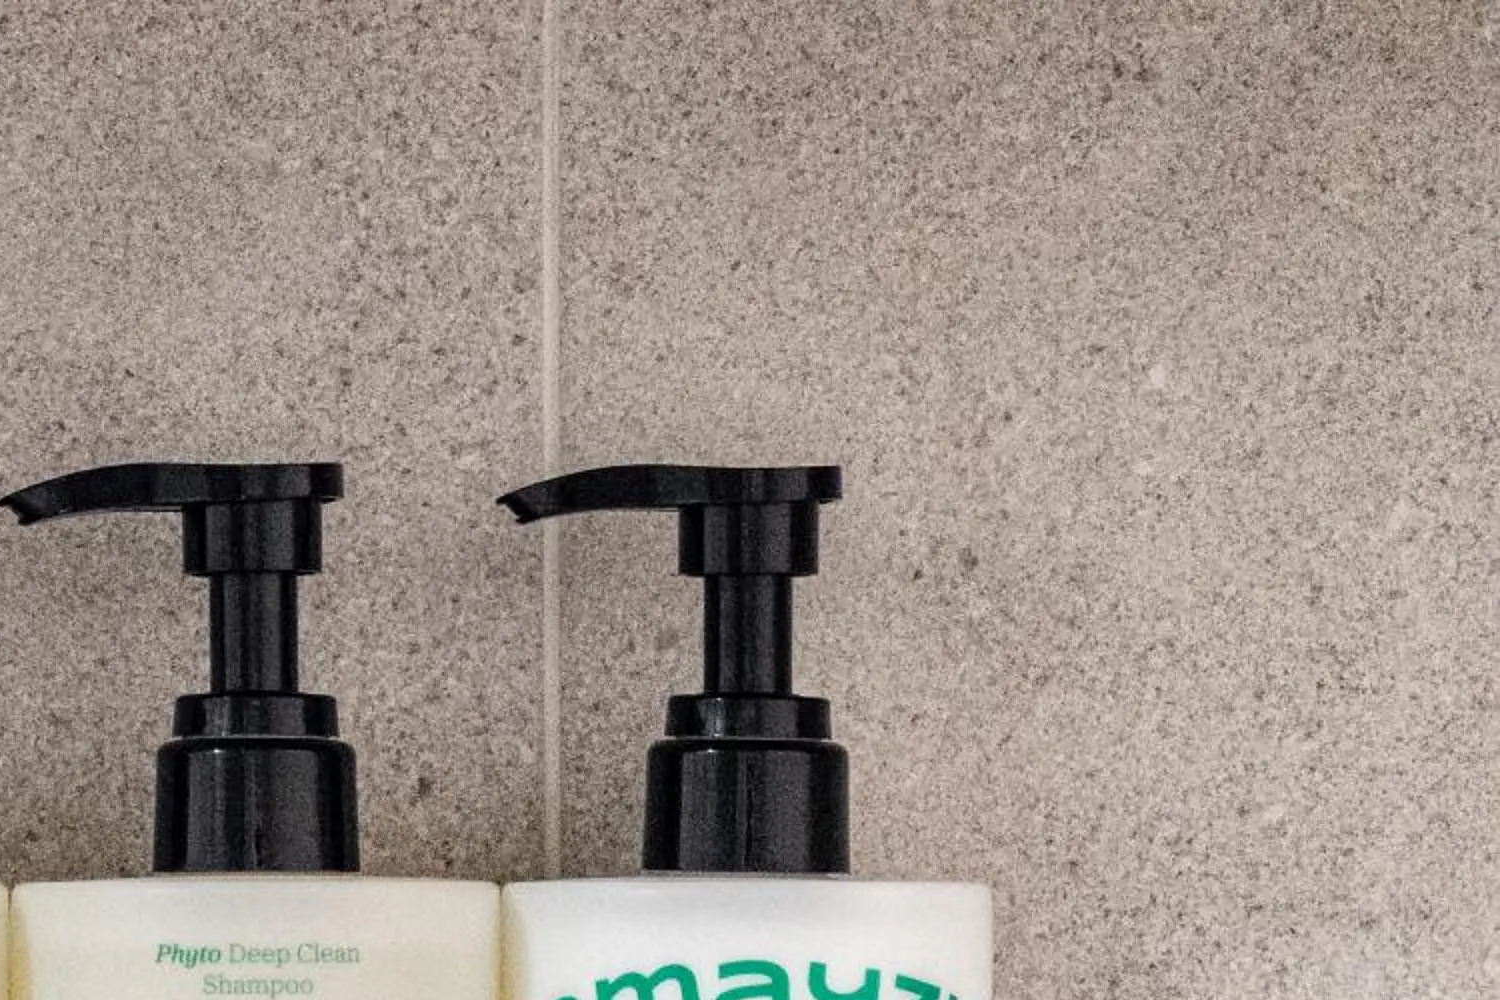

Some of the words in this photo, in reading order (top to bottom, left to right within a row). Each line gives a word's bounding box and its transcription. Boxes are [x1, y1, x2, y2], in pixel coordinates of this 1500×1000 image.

[156, 942, 222, 969] Phyto
[228, 943, 289, 970] Deep
[296, 943, 361, 965] Clean
[202, 974, 314, 1000] Shampoo
